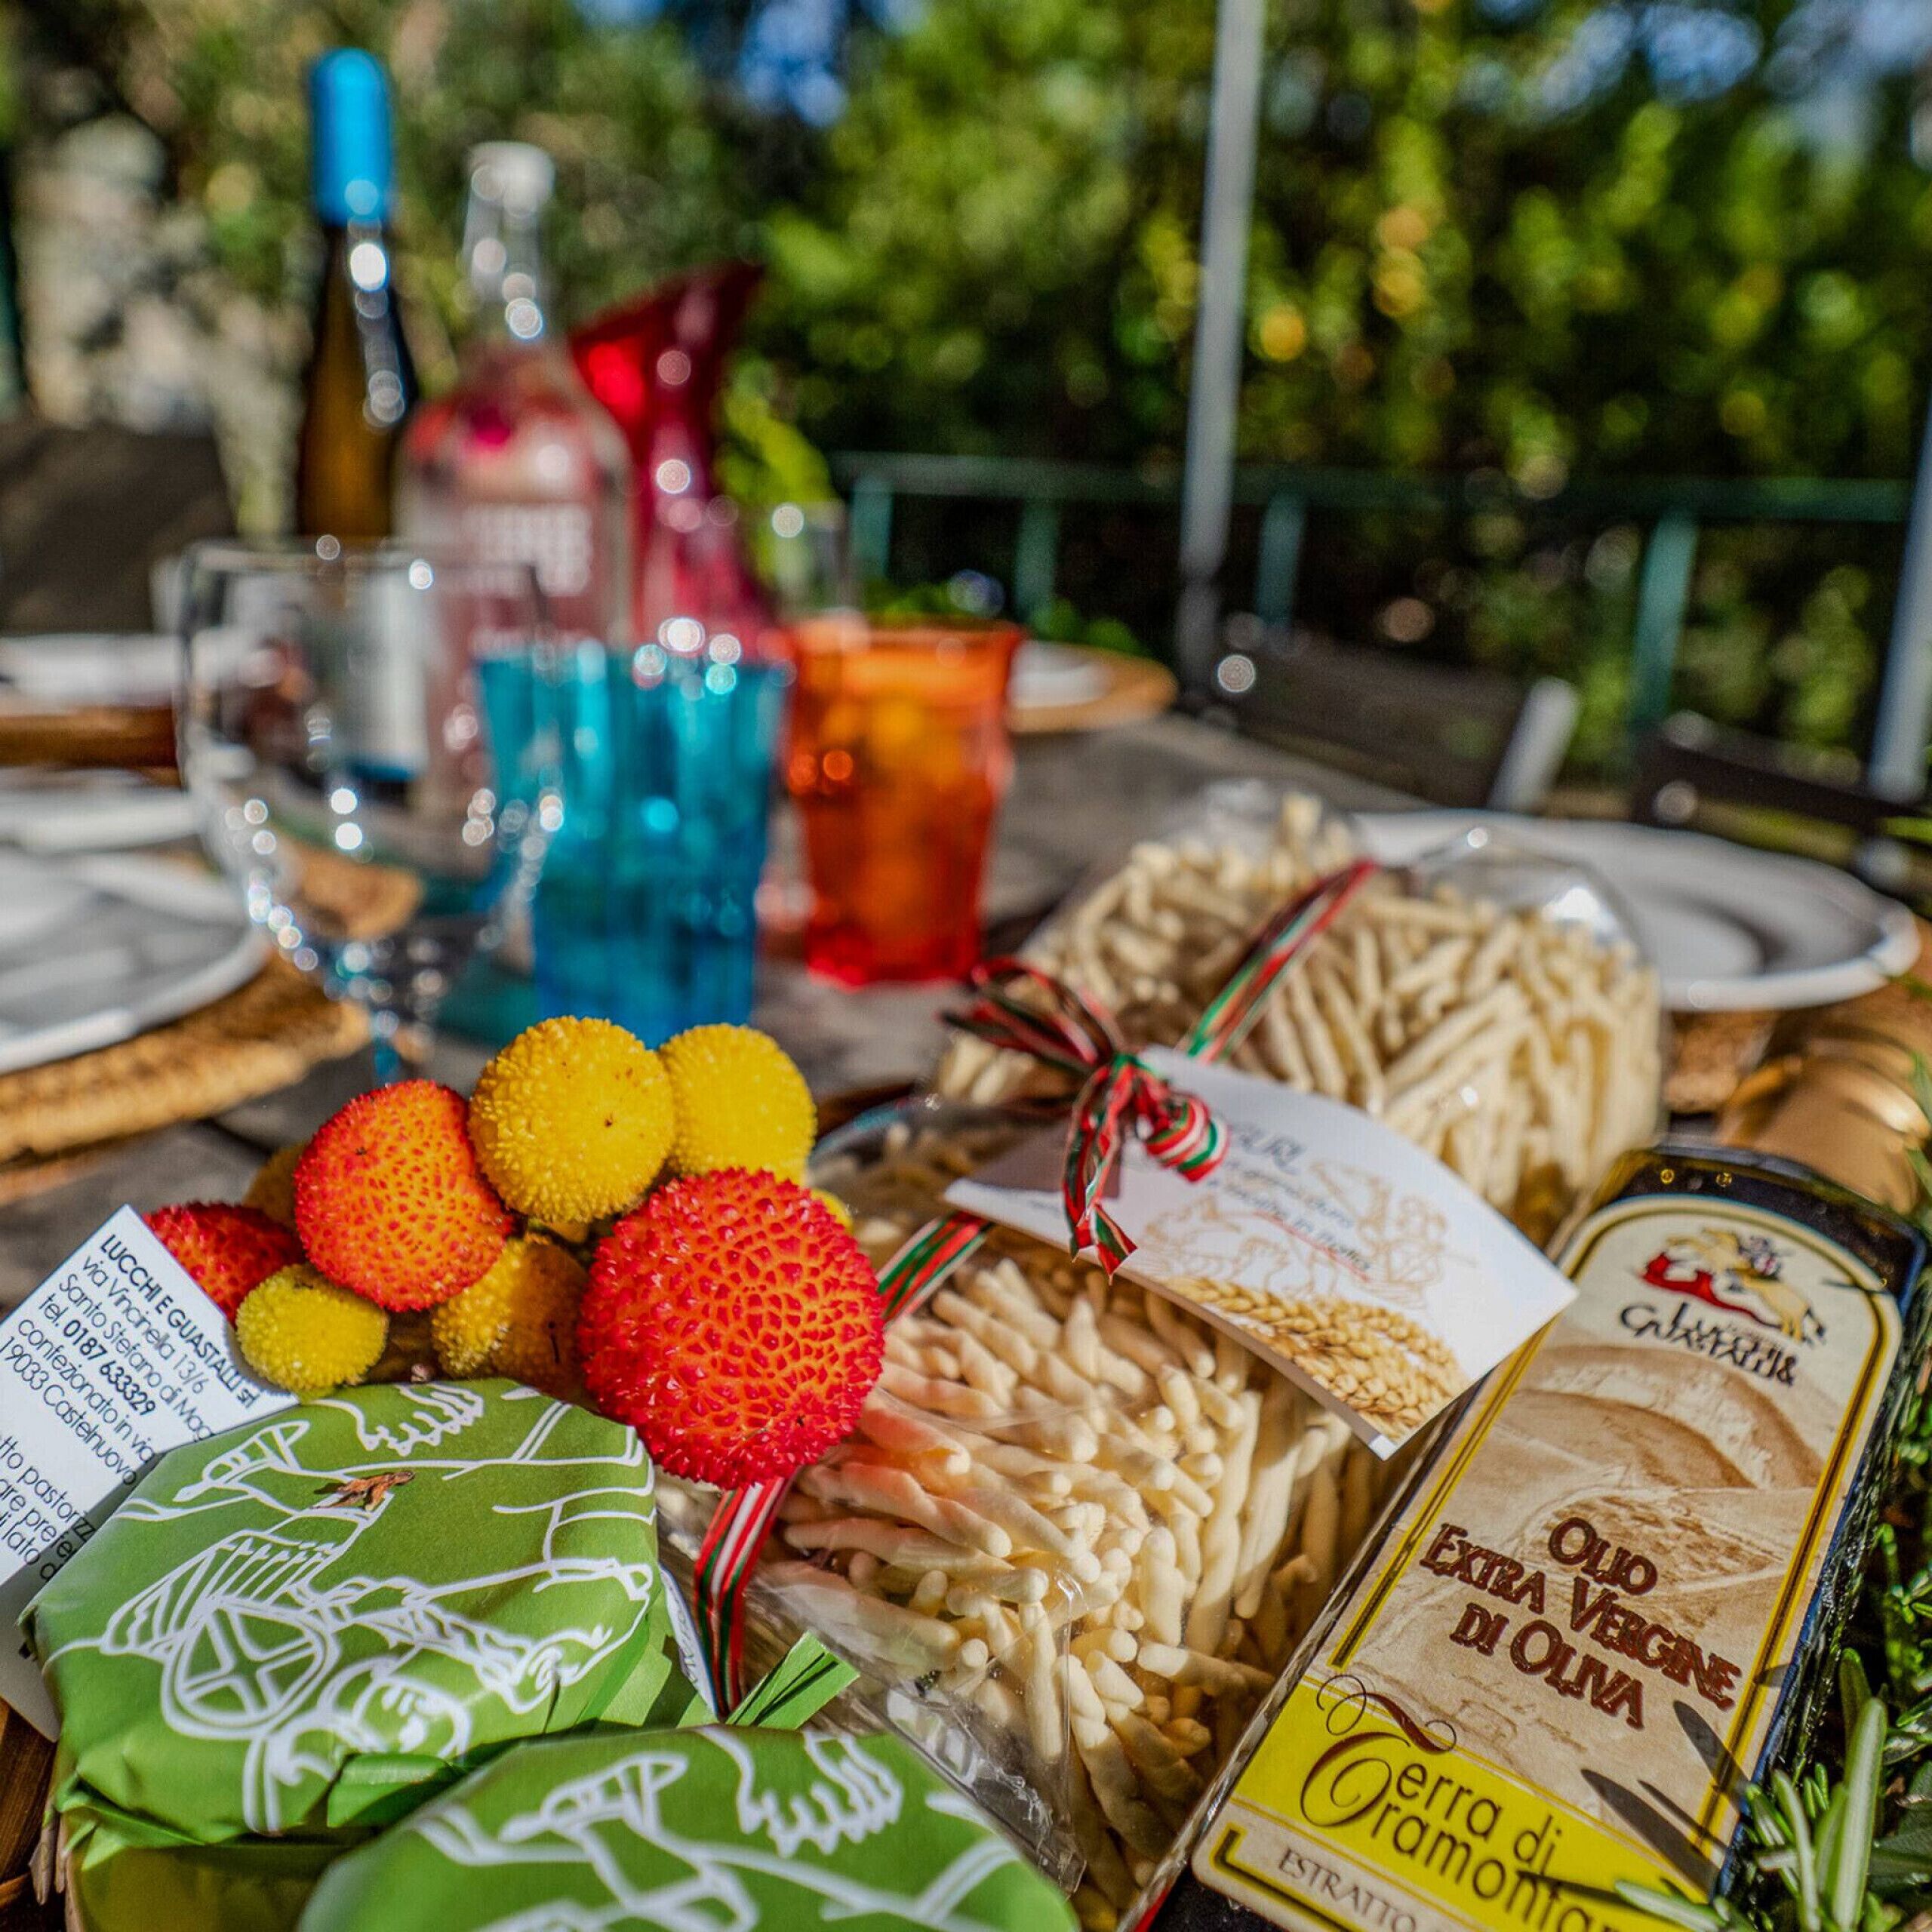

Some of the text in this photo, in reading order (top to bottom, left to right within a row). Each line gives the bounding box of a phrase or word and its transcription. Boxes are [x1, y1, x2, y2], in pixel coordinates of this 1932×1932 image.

[38, 1293, 156, 1416] tel. 0187 633329
[59, 1274, 106, 1327] Santo
[103, 1321, 162, 1388] Stefano
[159, 1385, 182, 1405] di
[83, 1256, 109, 1287] via
[174, 1354, 209, 1394] 13/6
[100, 1234, 163, 1303] LUCCHI
[155, 1294, 174, 1314] E
[168, 1309, 244, 1392] GUASTALLI
[0, 1335, 137, 1485] 19033 Castelnuovo
[18, 1319, 155, 1463] confezionato in via
[1420, 1523, 1743, 1712] EXTRA VERGINE
[1548, 1517, 1658, 1596] OLIO
[1449, 1602, 1645, 1730] DI OLIVA
[1300, 1674, 1562, 1877] Terra di
[1278, 1847, 1417, 1932] ESTRATTO
